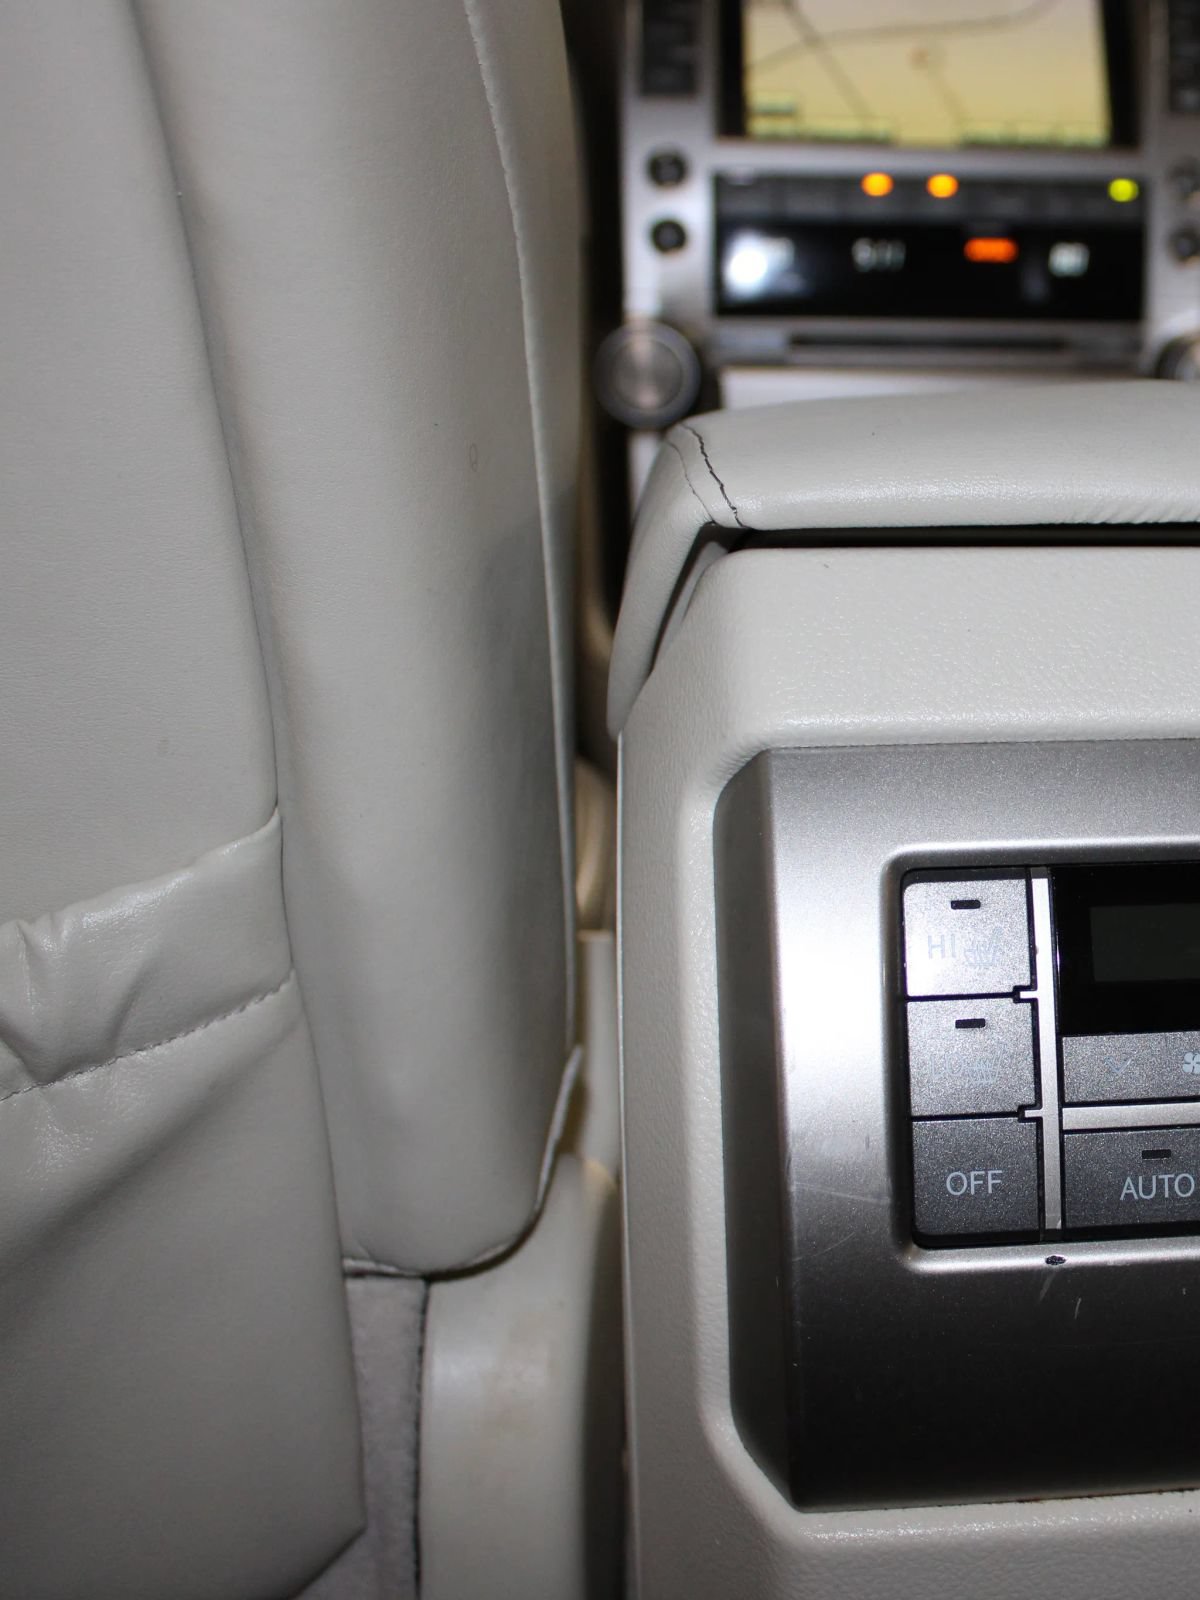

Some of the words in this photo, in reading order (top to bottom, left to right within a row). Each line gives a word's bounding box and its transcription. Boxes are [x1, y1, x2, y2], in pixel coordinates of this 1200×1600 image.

[927, 934, 957, 960] HI
[945, 1170, 1003, 1196] OFF
[1120, 1173, 1196, 1200] AUTO
